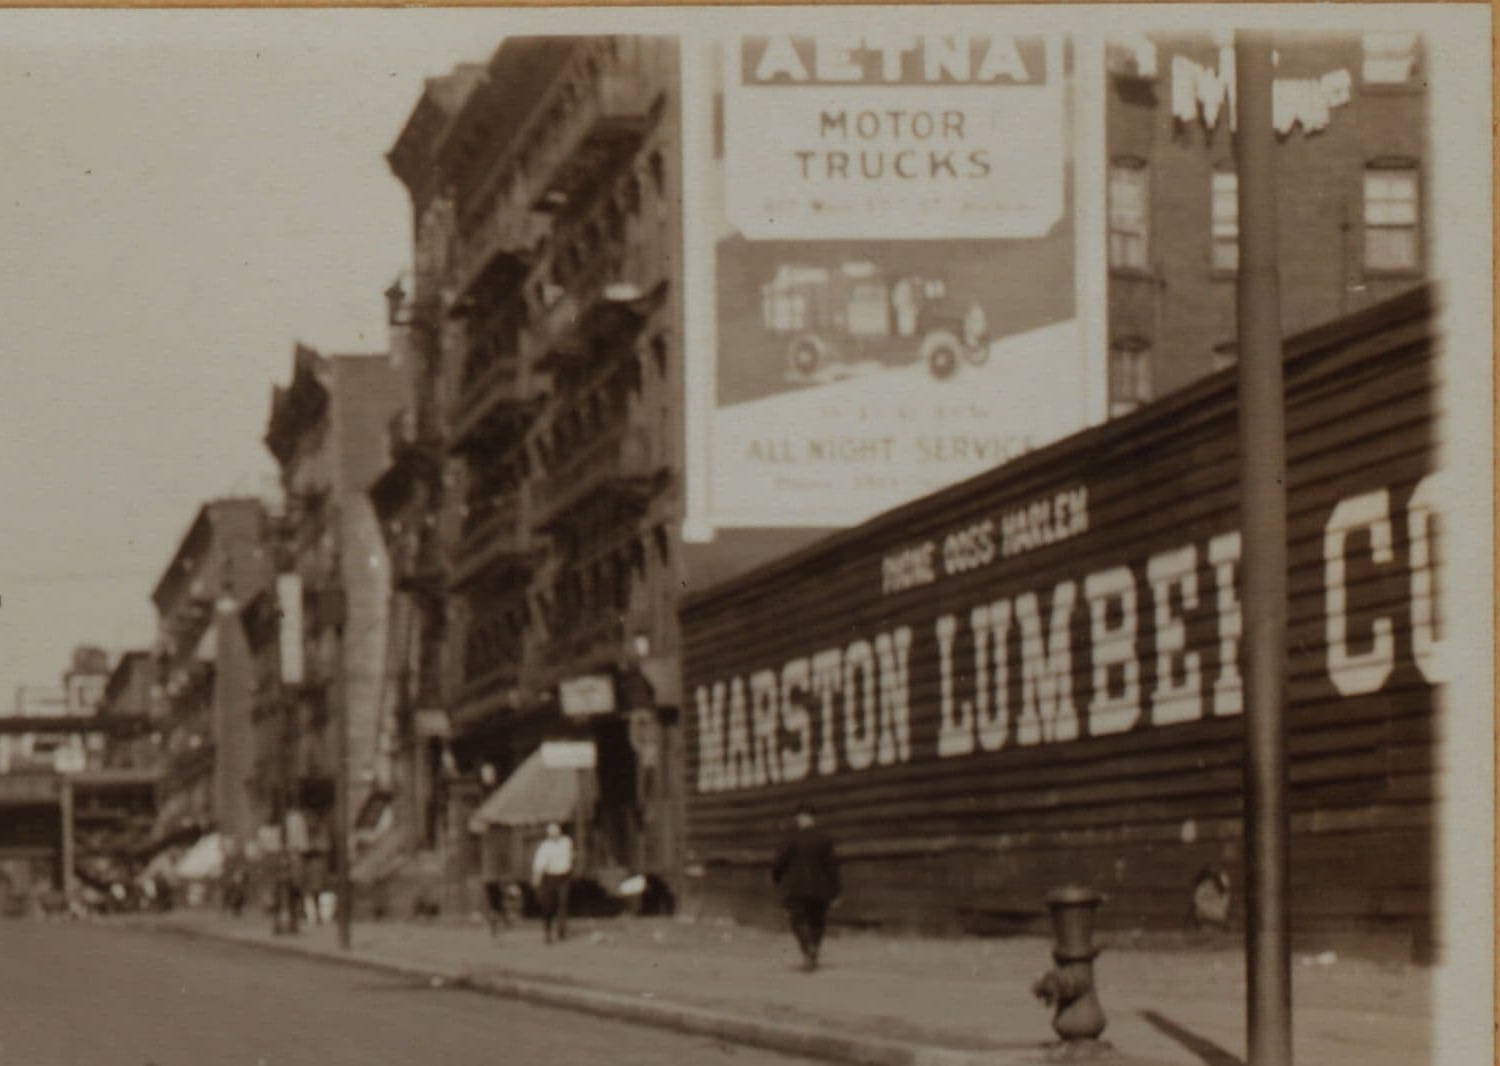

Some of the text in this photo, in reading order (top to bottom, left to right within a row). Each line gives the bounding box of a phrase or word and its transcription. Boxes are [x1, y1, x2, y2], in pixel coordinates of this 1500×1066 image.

[755, 34, 1032, 82] AETNA
[818, 110, 966, 140] MOTOR
[794, 149, 992, 180] TRUCKS
[746, 437, 796, 463] ALL
[807, 436, 895, 463] NIGHT
[1001, 484, 1090, 558] HARLEM
[695, 623, 913, 793] MARSTON
